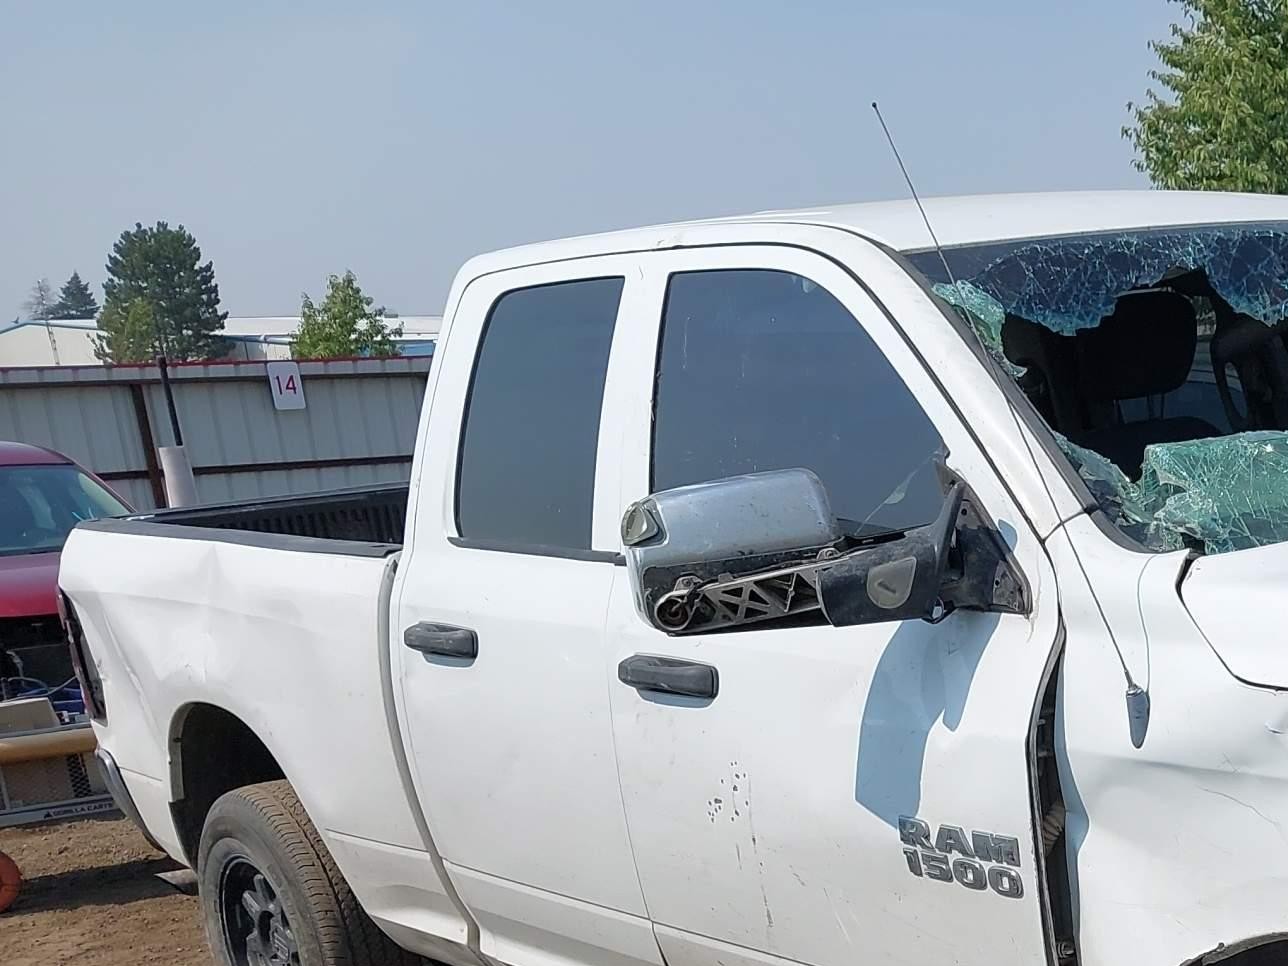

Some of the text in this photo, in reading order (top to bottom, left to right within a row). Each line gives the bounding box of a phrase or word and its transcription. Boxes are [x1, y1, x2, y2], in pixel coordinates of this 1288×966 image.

[275, 374, 297, 395] 14
[898, 814, 1021, 868] RAM
[902, 847, 1024, 899] 1500
